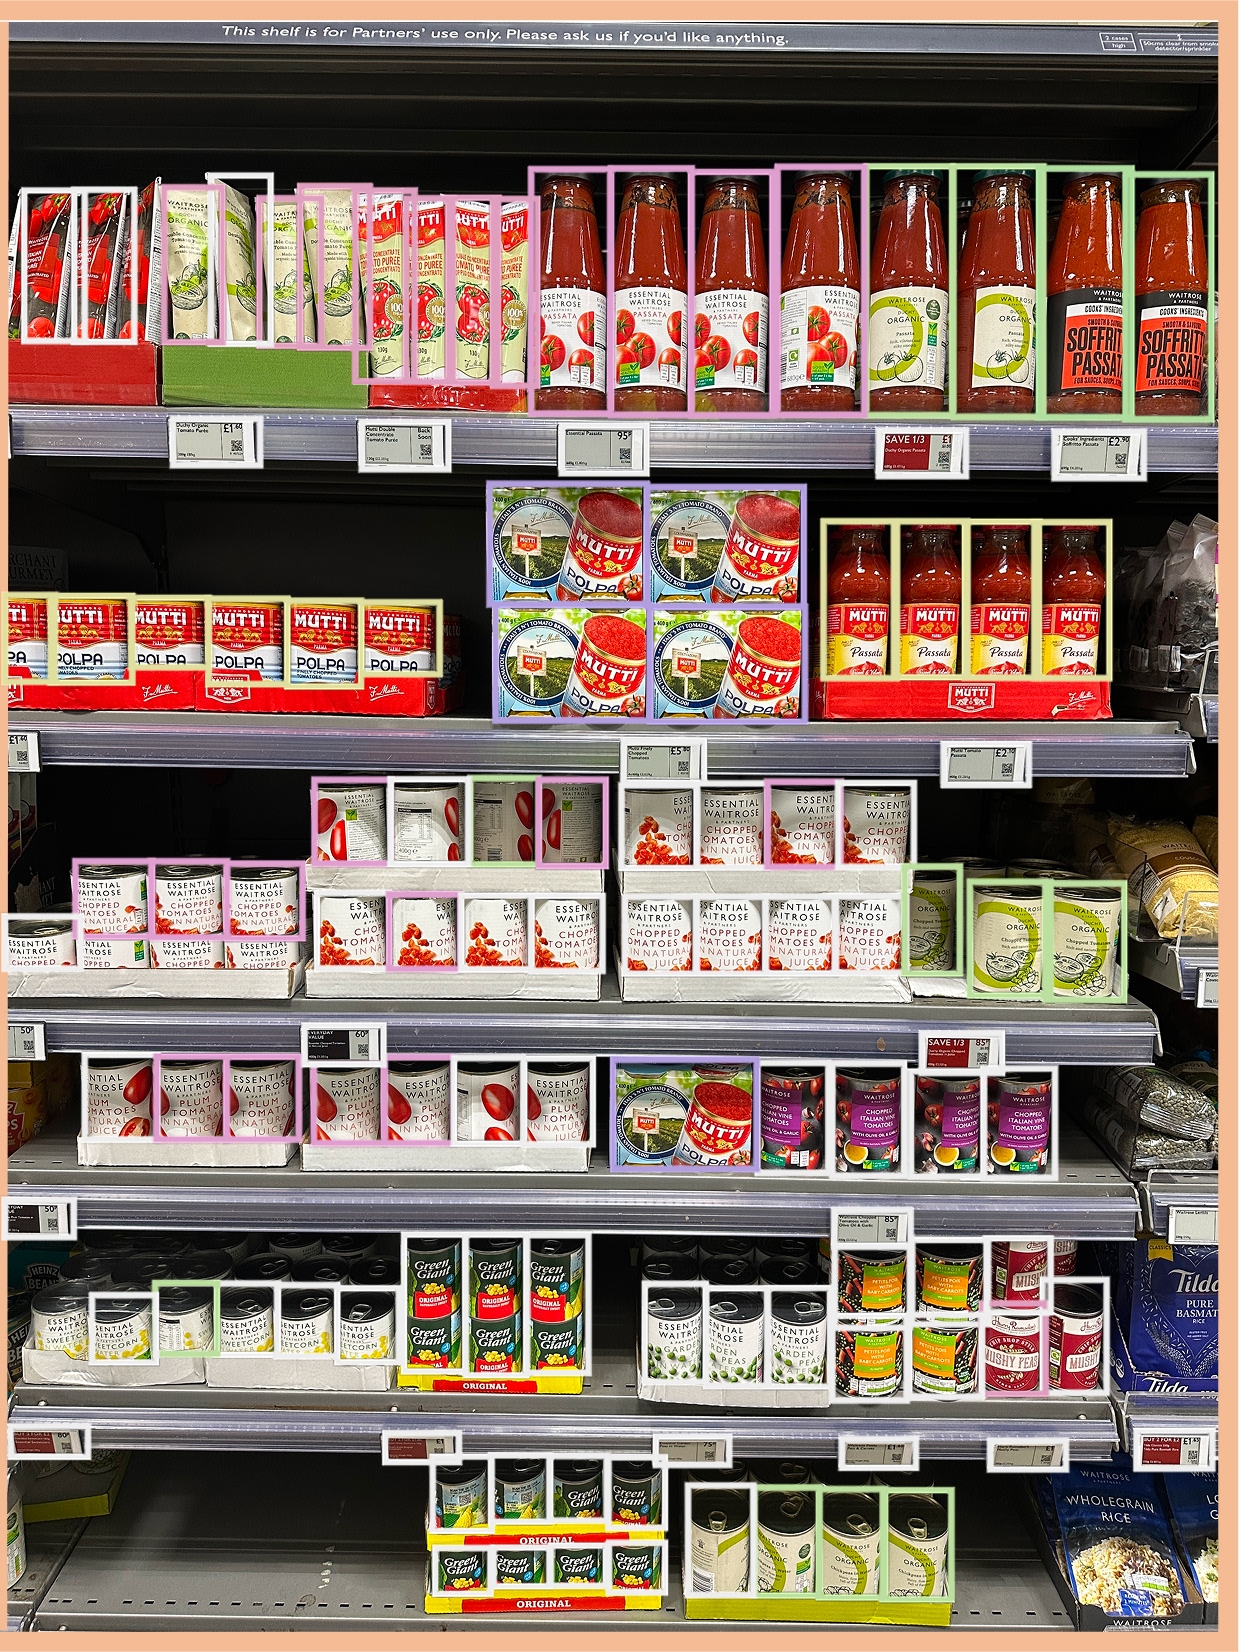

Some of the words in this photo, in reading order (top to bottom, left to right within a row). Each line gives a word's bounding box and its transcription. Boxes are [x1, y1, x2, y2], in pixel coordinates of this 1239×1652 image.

[222, 26, 256, 37] This
[261, 26, 301, 37] shelf
[305, 27, 318, 37] is
[323, 27, 347, 38] for
[431, 30, 459, 38] use
[465, 29, 502, 42] only.
[505, 29, 558, 40] Please
[564, 29, 589, 42] ask
[595, 33, 613, 42] us
[619, 30, 630, 42] if
[682, 31, 711, 43] like
[716, 32, 789, 46] anything.
[539, 294, 582, 302] ESSENTIAL
[1168, 292, 1203, 301] WAITROSE
[539, 301, 582, 309] WAITROSE
[887, 316, 926, 324] ORGANIC
[885, 435, 908, 444] SAVE
[910, 435, 925, 445] 1/3
[732, 533, 790, 565] MUTTI
[295, 613, 347, 630] MUTTI
[297, 657, 345, 671] POLPA
[580, 648, 639, 683] MUTTI
[954, 688, 989, 697] MUTTI
[1006, 923, 1041, 931] ORGANIC
[654, 957, 683, 969] JUICE
[478, 1260, 512, 1272] Green
[480, 1266, 514, 1281] Giant
[481, 1296, 511, 1304] ORIGINAL
[1186, 1300, 1214, 1308] PURE
[463, 1382, 507, 1390] ORIGINAL
[1066, 1494, 1155, 1514] WHOLEGRAIN
[1101, 1511, 1132, 1524] RICE
[516, 1598, 571, 1608] ORIGINAL
